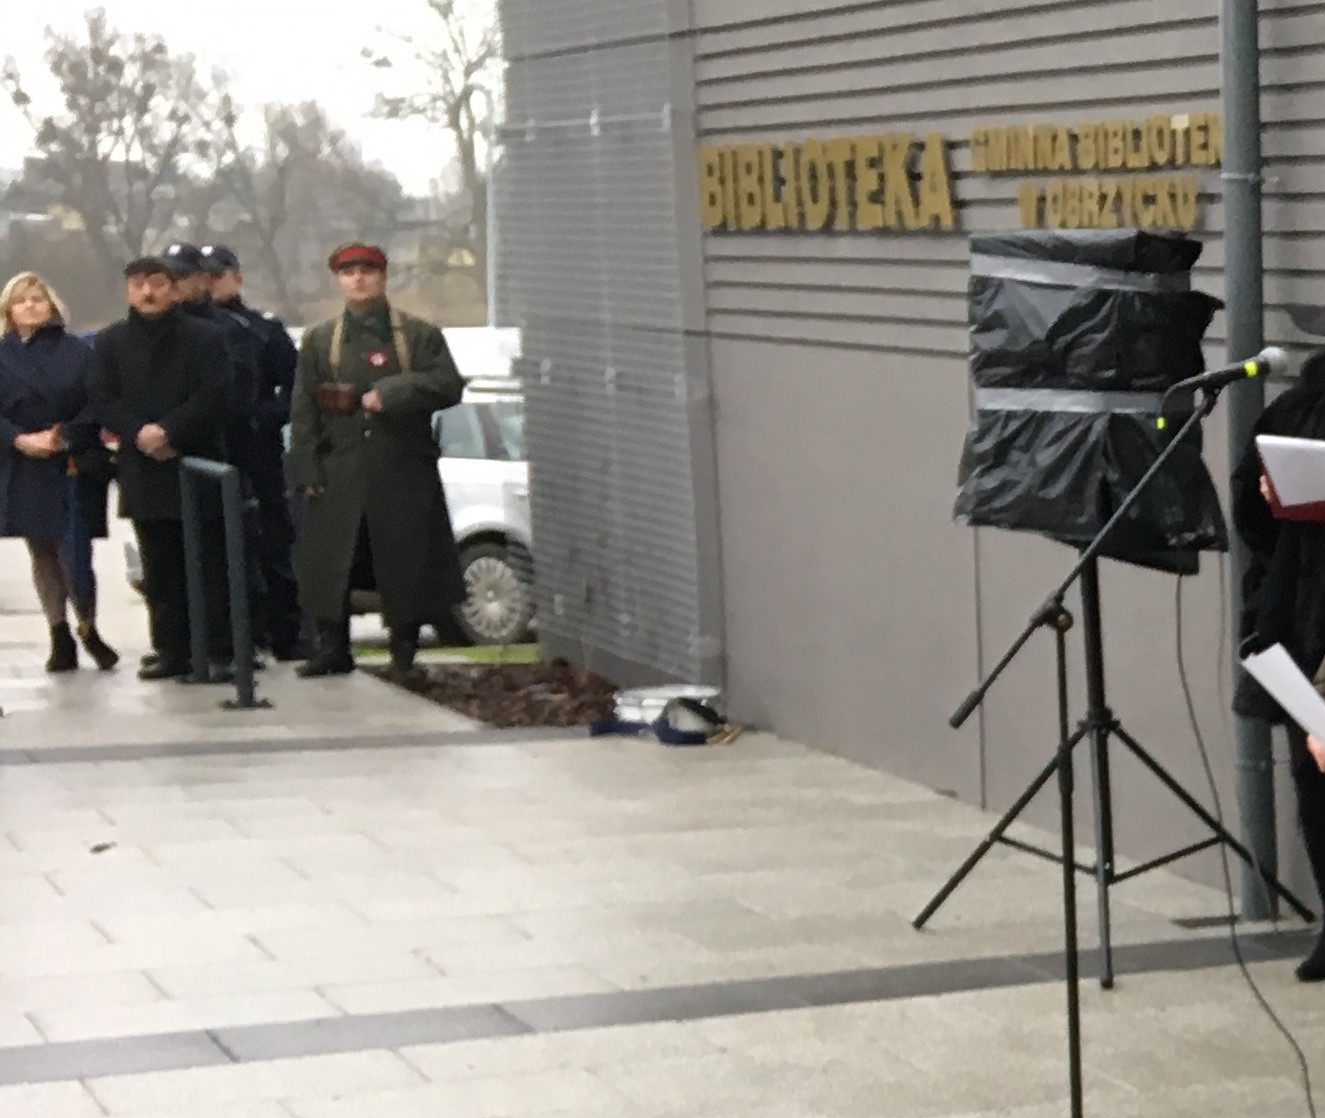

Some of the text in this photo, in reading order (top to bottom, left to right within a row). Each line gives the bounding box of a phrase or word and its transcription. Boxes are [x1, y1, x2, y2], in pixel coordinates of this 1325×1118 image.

[970, 124, 1069, 172] GMINNA
[698, 132, 955, 229] BIBLIOTEKA
[1047, 175, 1197, 230] OBRZYCKU
